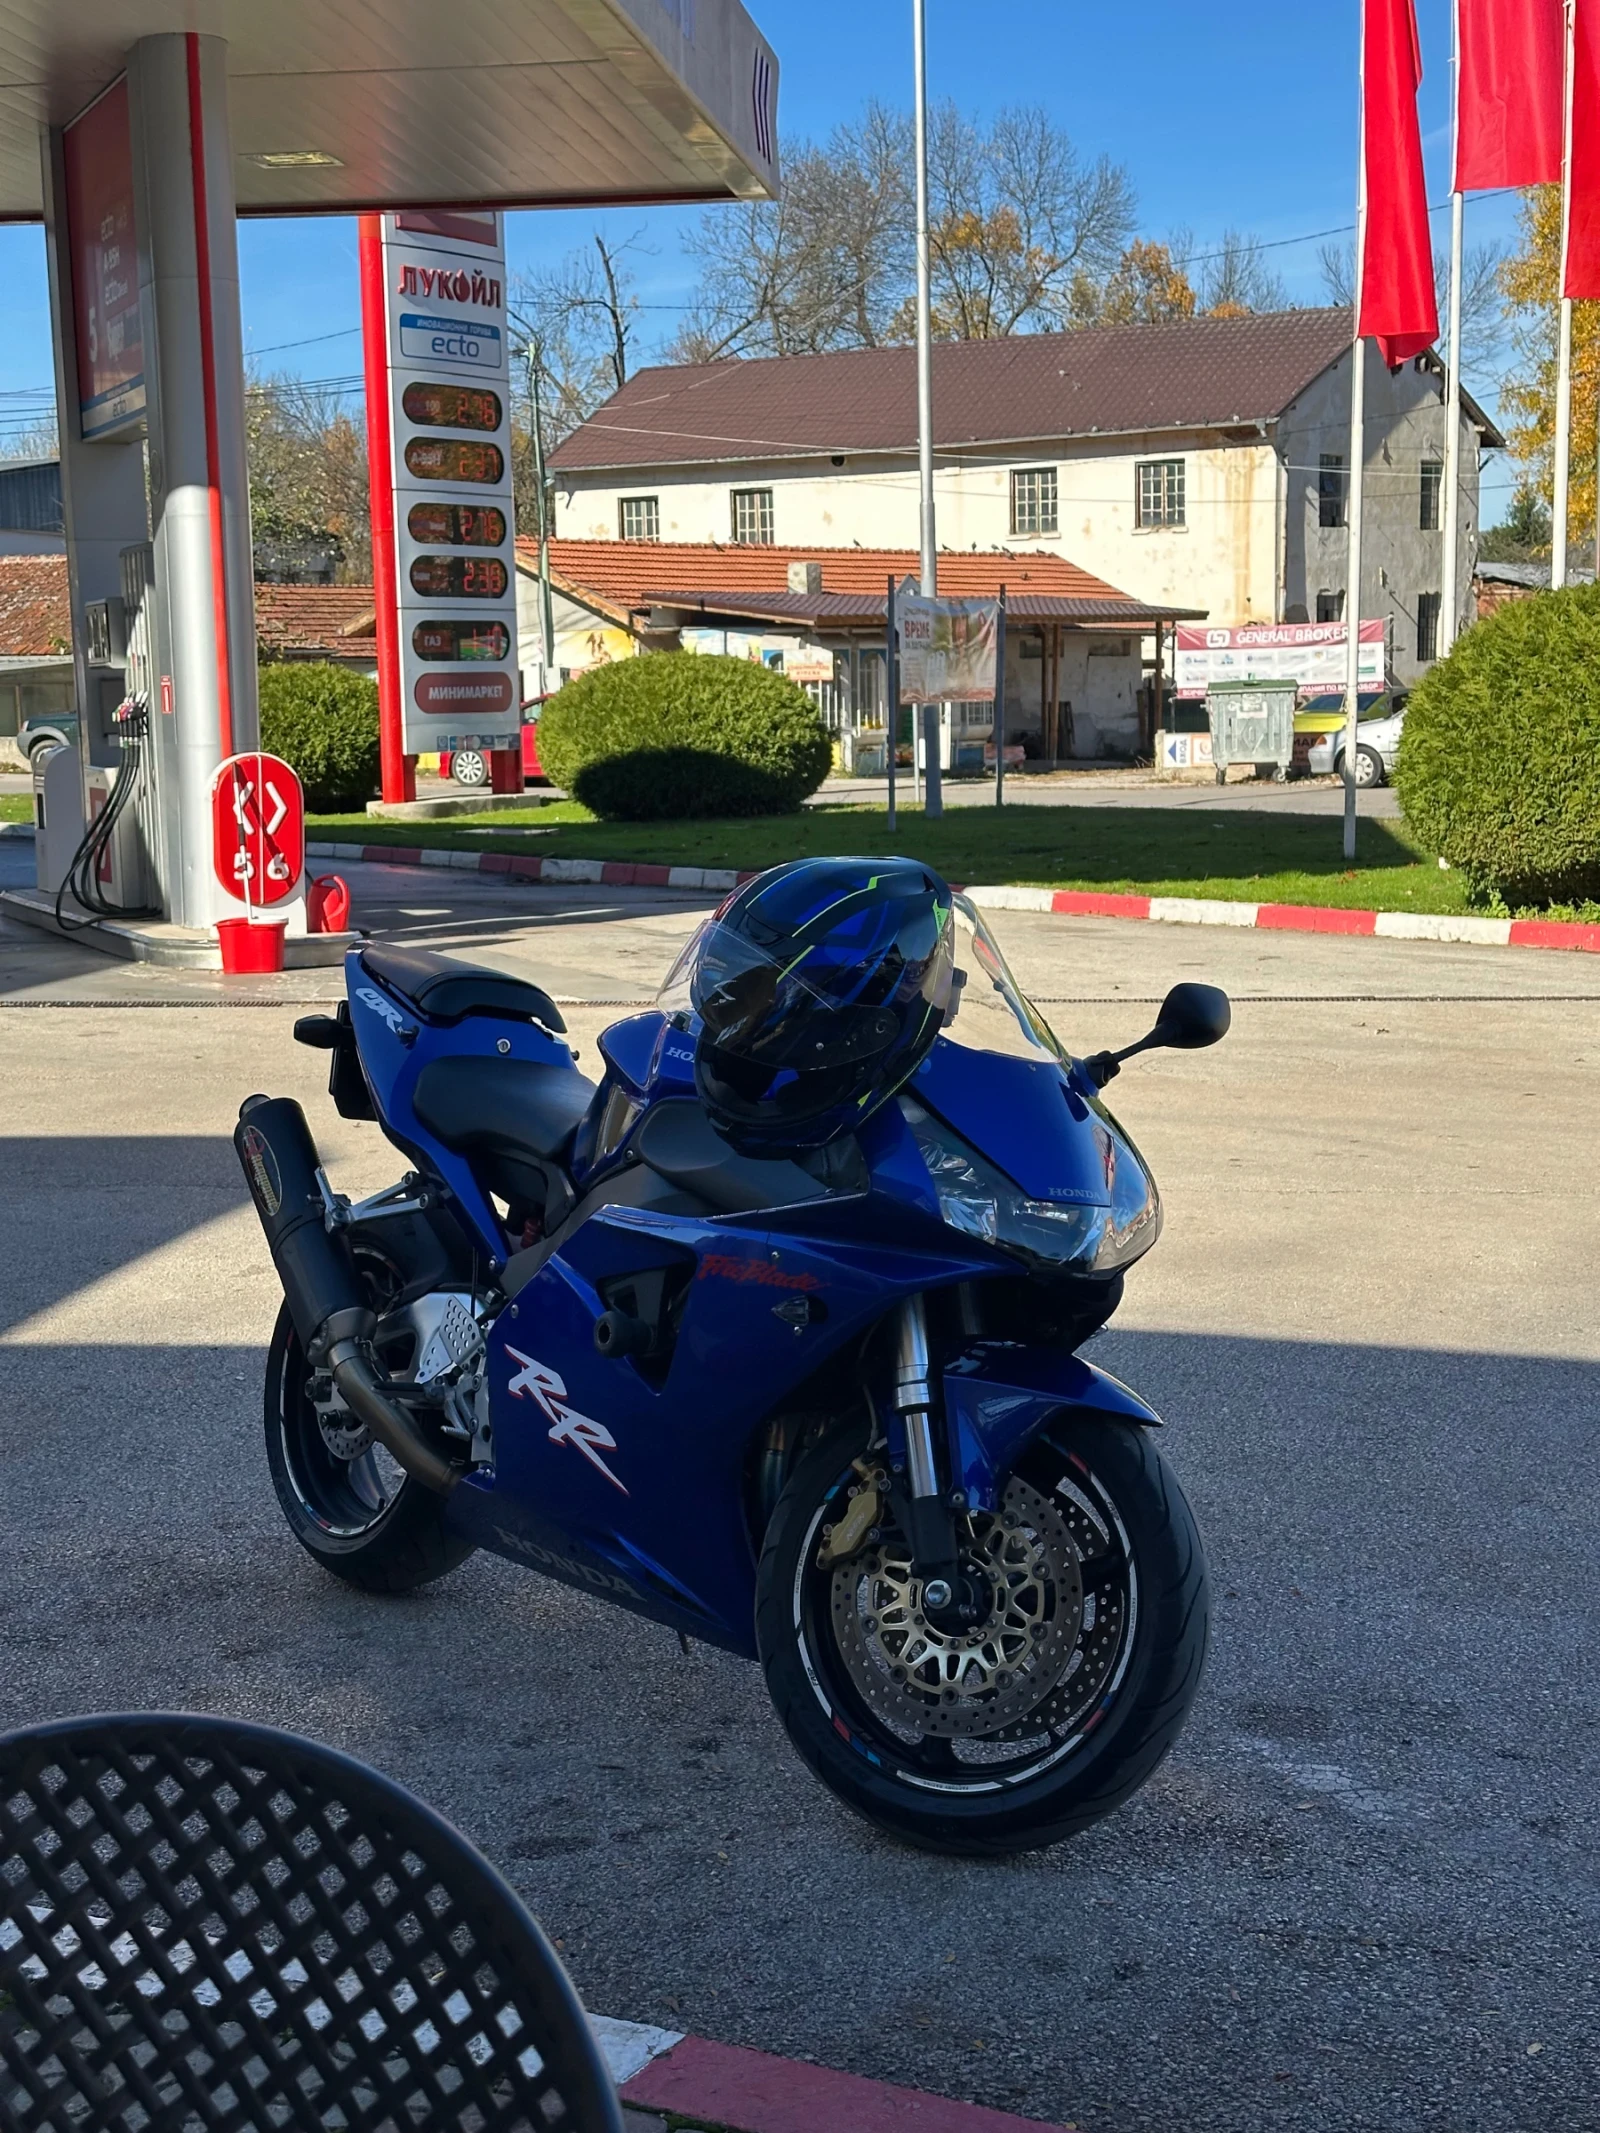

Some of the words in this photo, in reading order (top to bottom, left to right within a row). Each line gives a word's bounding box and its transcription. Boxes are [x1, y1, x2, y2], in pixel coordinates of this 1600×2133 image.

[397, 264, 501, 309] ЛУКОЙЛ
[88, 304, 98, 364] 5
[431, 335, 480, 358] ecto
[1236, 629, 1291, 645] GENERAL
[1294, 626, 1348, 642] BROKER
[428, 685, 503, 700] МИНИМАРКЕТ
[233, 852, 255, 880] 5
[266, 852, 290, 880] 6
[1047, 1186, 1101, 1201] HONDA
[491, 1523, 648, 1603] HONDA
